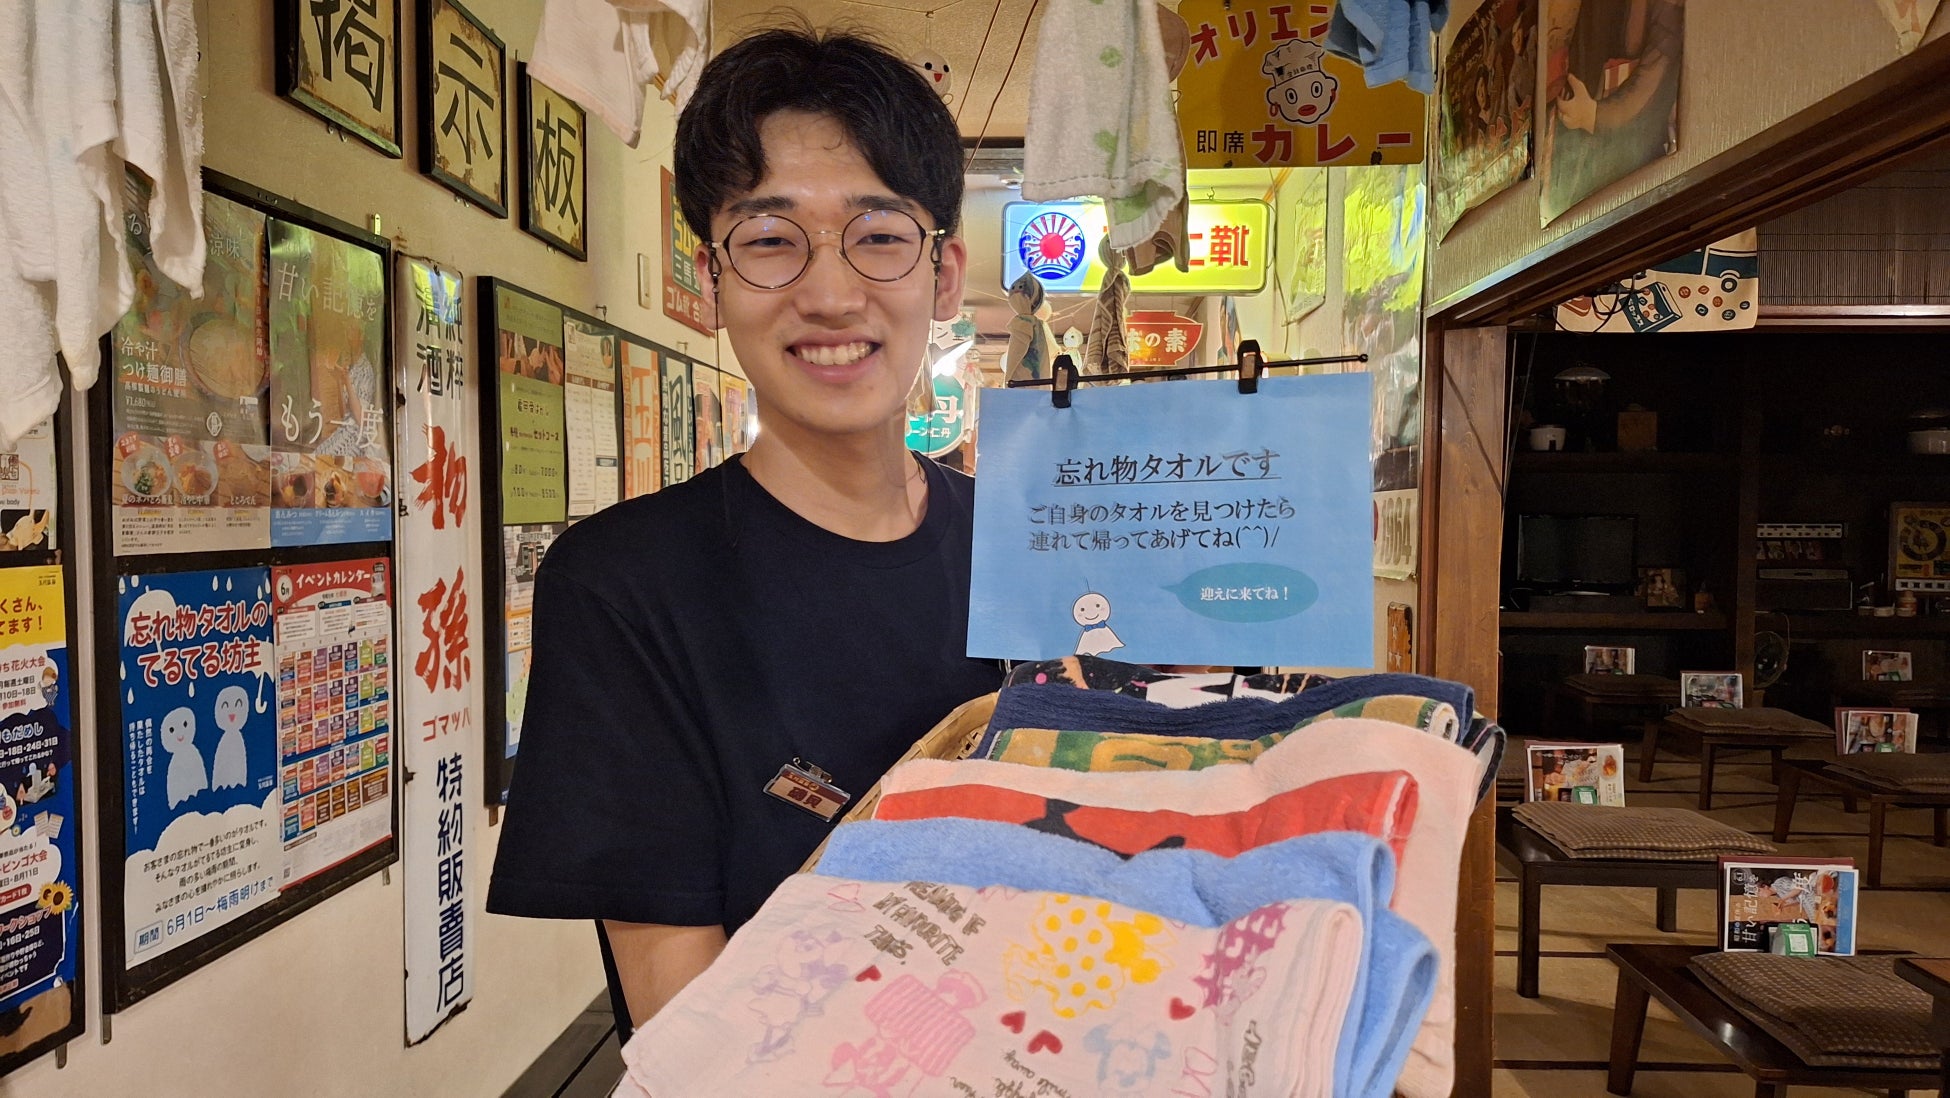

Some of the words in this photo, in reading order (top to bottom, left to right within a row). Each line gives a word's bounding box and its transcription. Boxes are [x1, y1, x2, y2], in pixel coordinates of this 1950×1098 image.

[439, 32, 494, 165] 示
[537, 101, 578, 226] 板
[1197, 130, 1244, 154] 即席
[1249, 124, 1412, 164] カレー
[281, 394, 384, 449] もう一度
[1054, 448, 1282, 486] 忘れ物タオルです
[1029, 497, 1296, 525] ご自身のタオルを見つけたら
[296, 569, 371, 589] イベントカレンダー
[129, 600, 268, 647] 忘れ物タオルの
[137, 634, 263, 687] てるてる坊主
[0, 721, 44, 742] もだめし
[0, 849, 48, 875] ビンゴ大会
[138, 926, 160, 948] 期間
